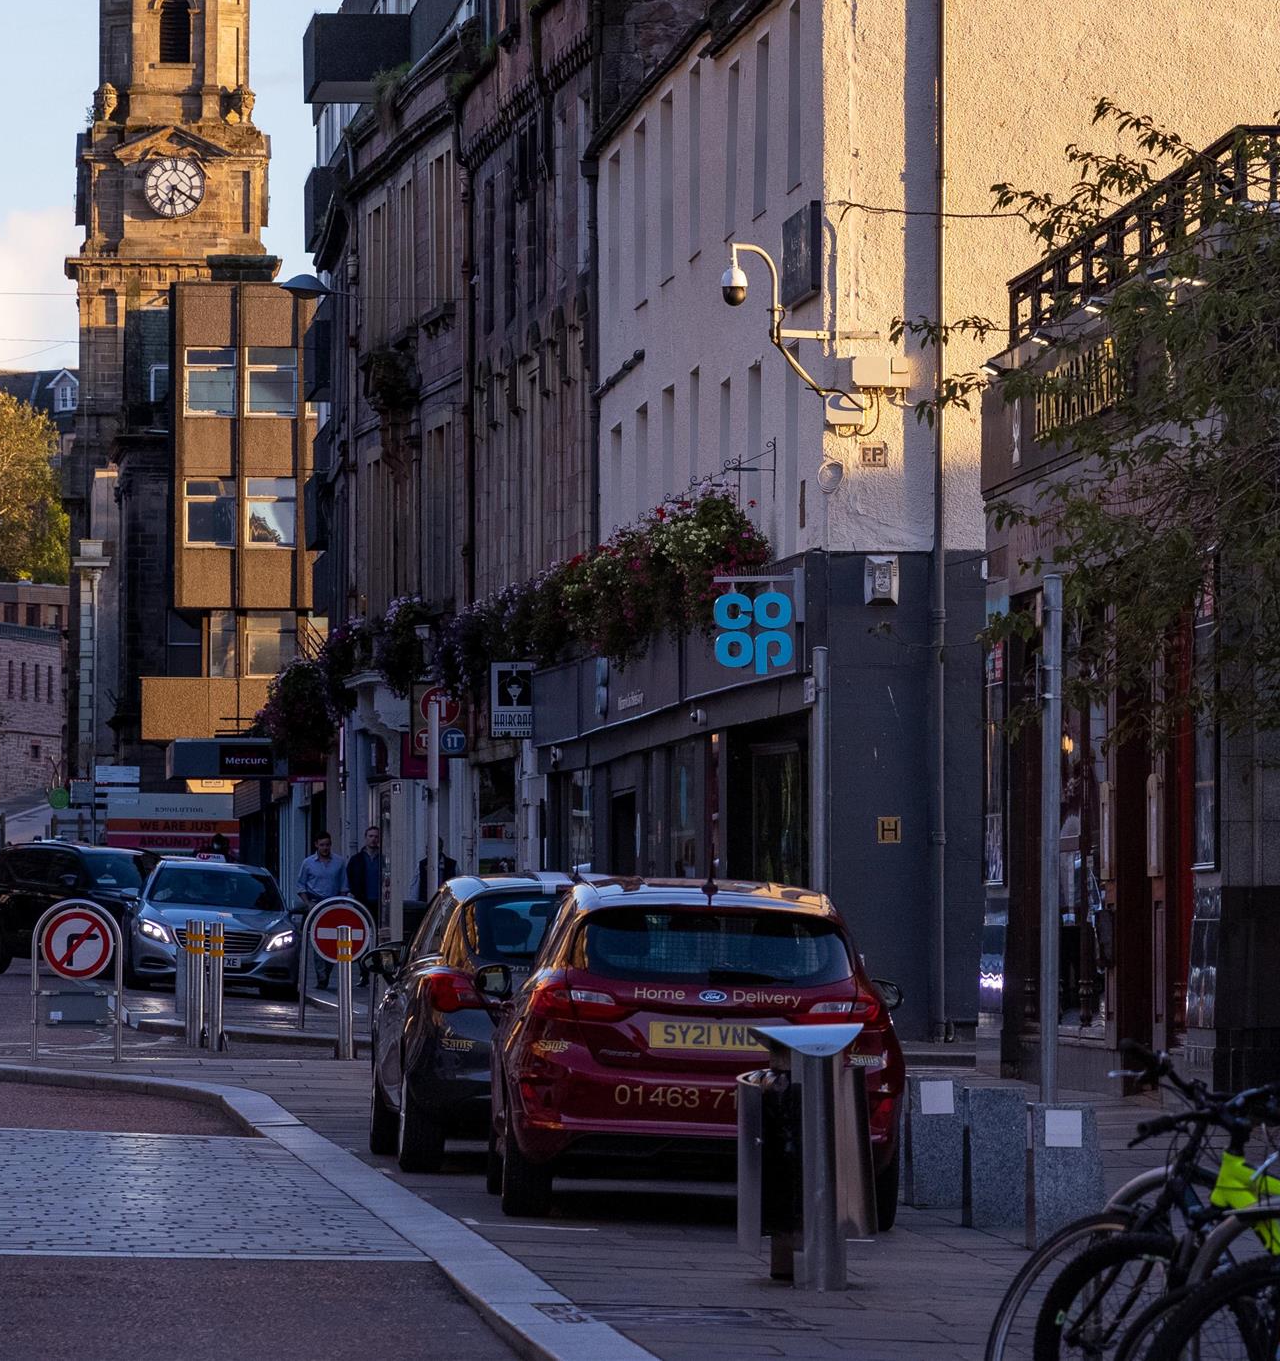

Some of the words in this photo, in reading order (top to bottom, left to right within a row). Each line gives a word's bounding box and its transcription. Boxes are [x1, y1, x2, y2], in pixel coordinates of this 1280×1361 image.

[225, 755, 269, 765] Mercure
[139, 821, 159, 831] WE
[163, 821, 186, 831] ARE
[191, 821, 218, 831] JUST
[881, 820, 898, 840] H
[139, 836, 191, 846] AROUND
[634, 987, 686, 1000] Home
[733, 989, 802, 1007] Delivery
[663, 1025, 711, 1045] SY21
[614, 1084, 701, 1109] 01463
